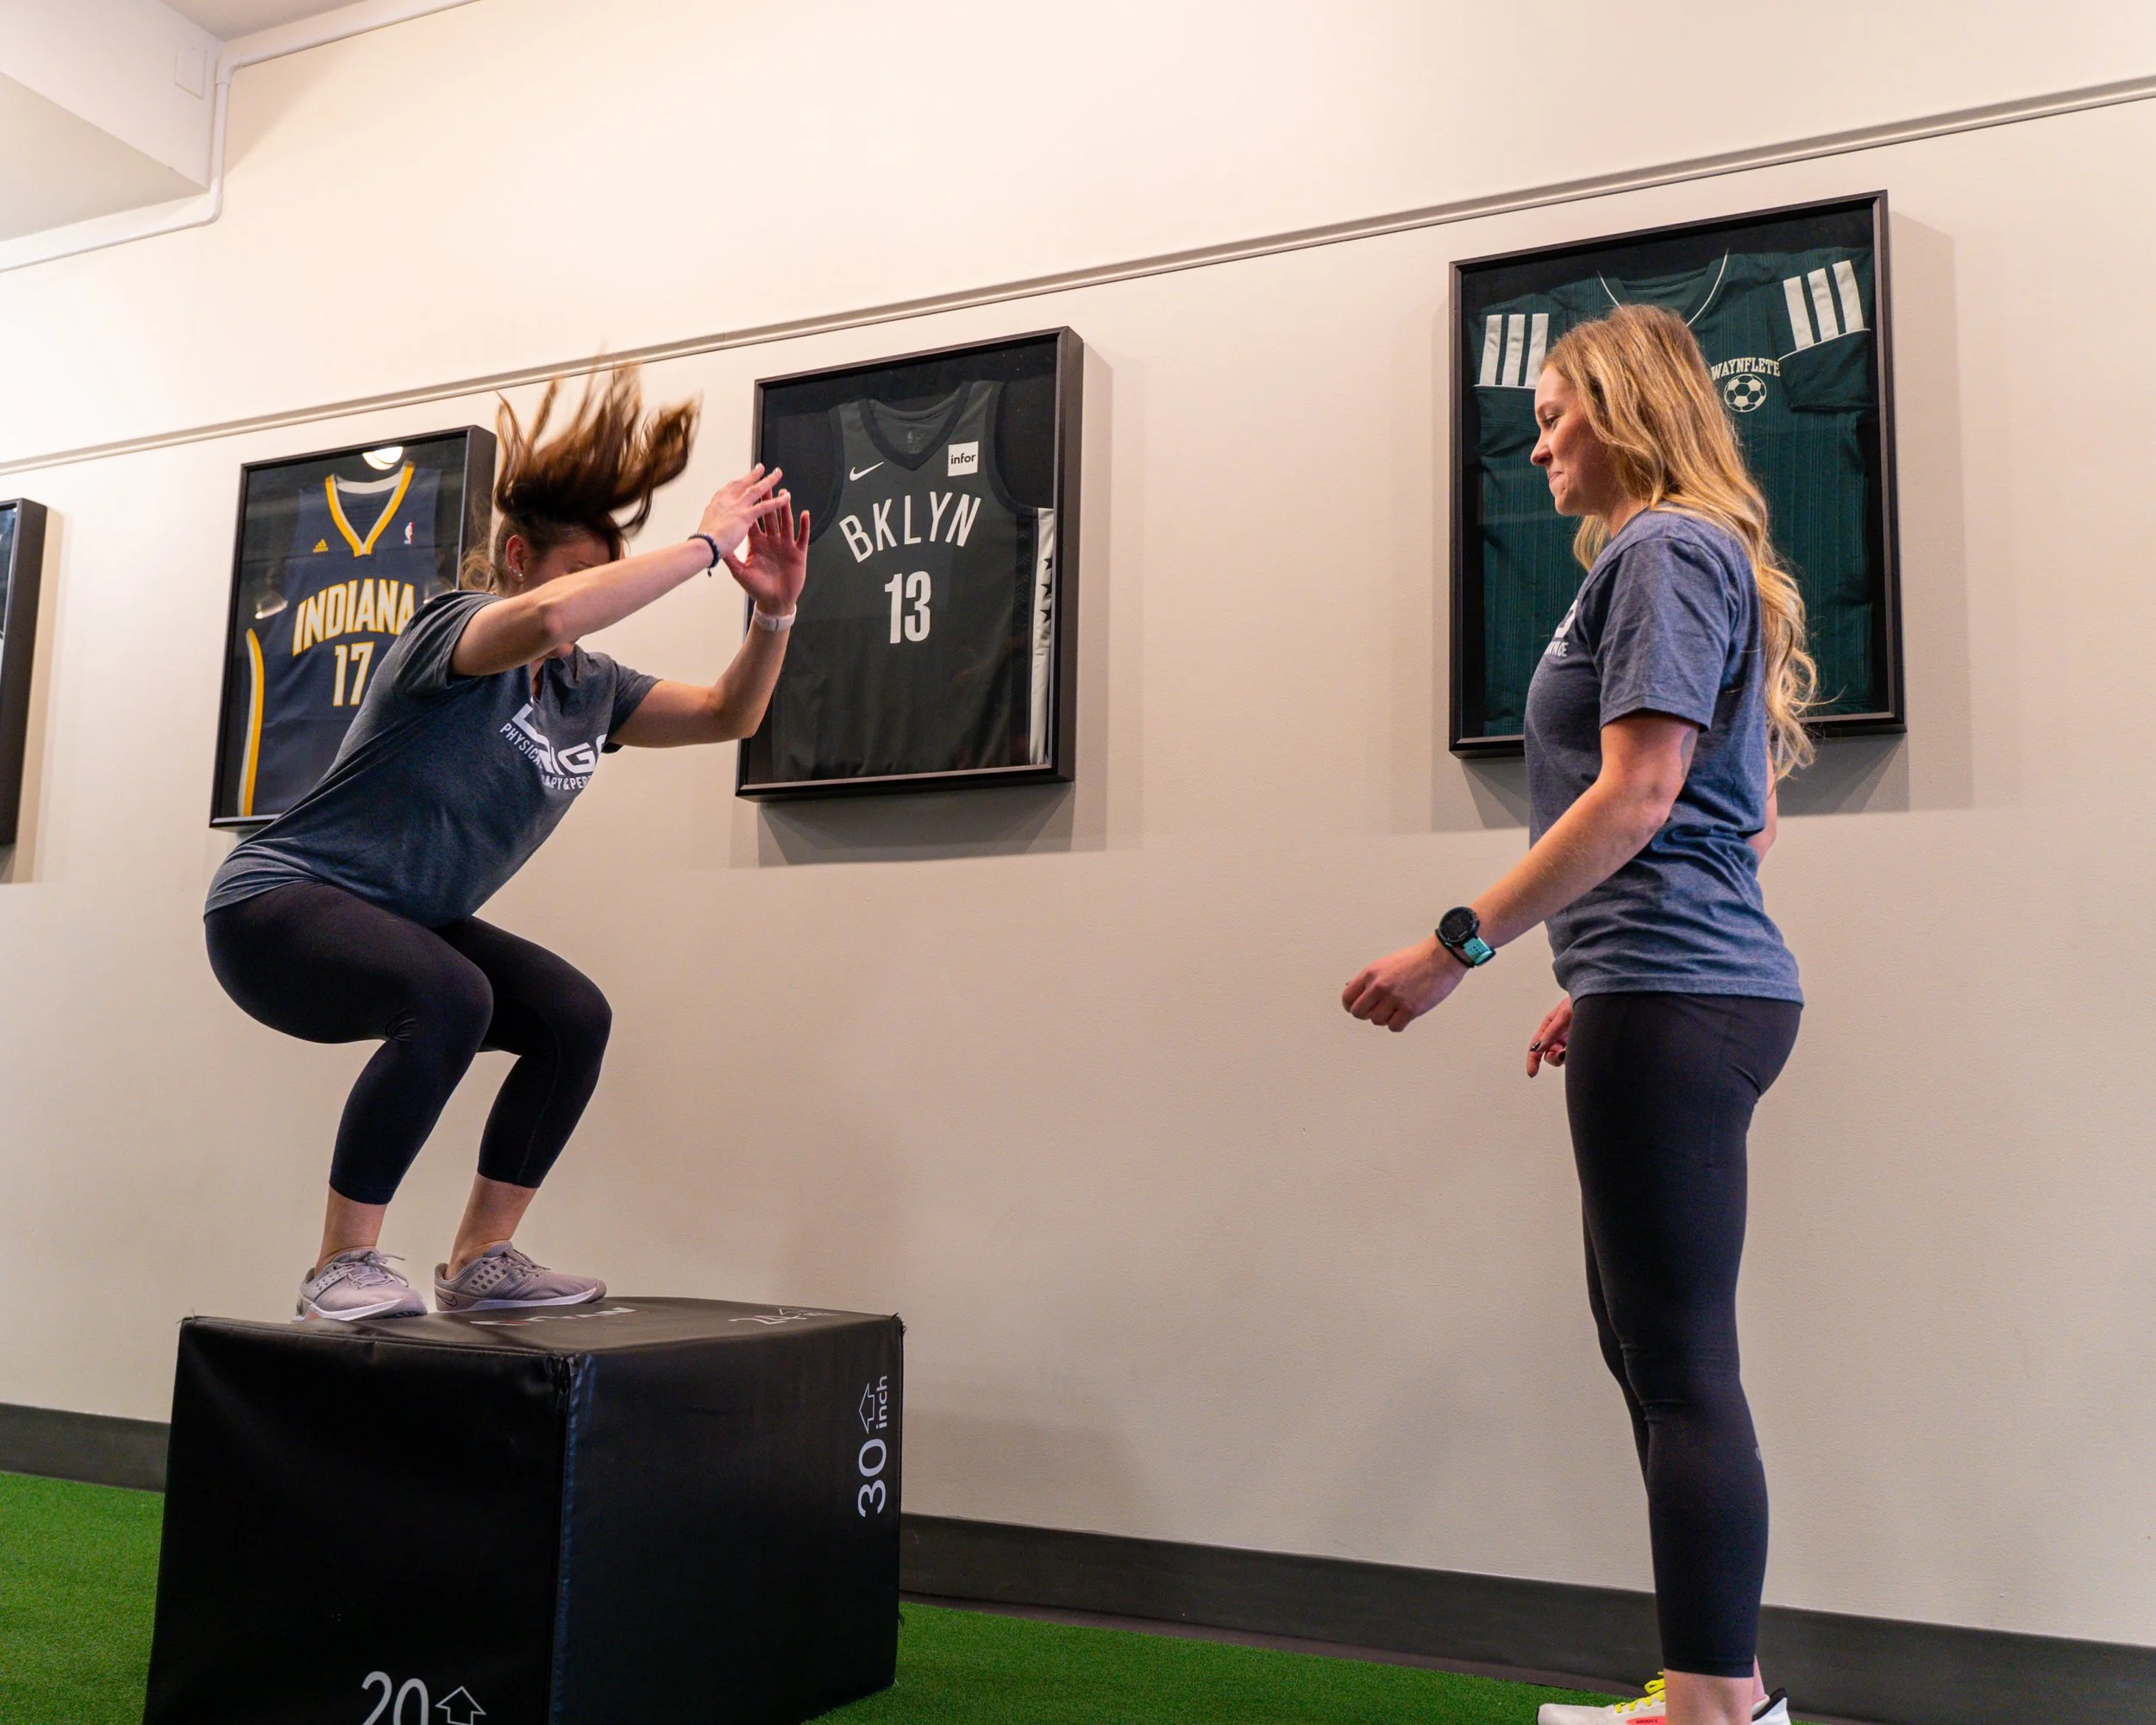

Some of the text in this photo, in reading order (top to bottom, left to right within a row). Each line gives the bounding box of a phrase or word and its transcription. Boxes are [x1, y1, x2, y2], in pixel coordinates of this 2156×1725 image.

[1710, 357, 1781, 381] WAYNFLETE
[950, 453, 976, 466] infor
[839, 491, 981, 563] BKLYN
[292, 579, 415, 657] INDIANA
[884, 570, 931, 644] 13
[333, 642, 374, 706] 17
[857, 1375, 888, 1518] 30 inch
[361, 1671, 429, 1725] 20
